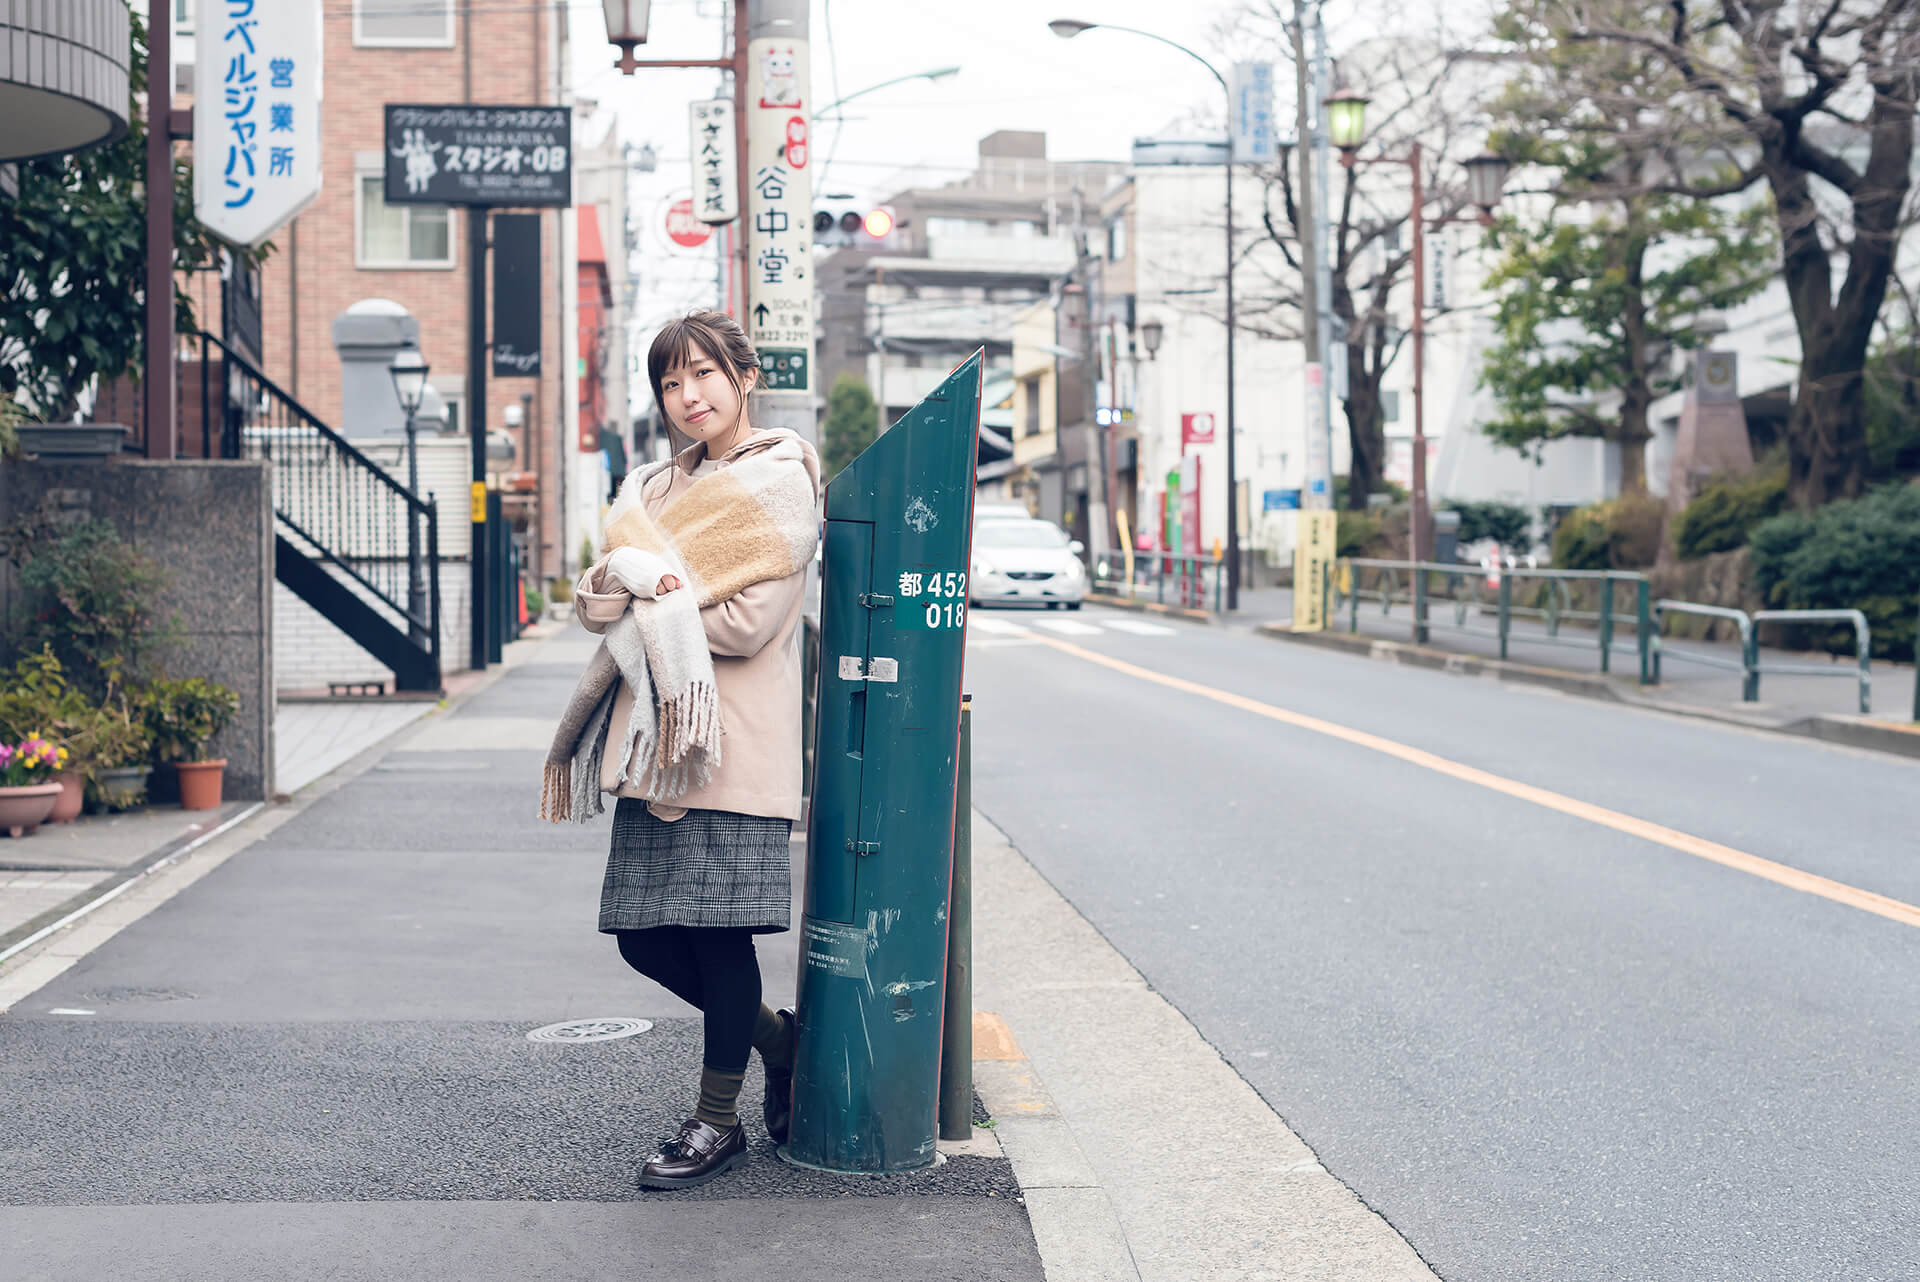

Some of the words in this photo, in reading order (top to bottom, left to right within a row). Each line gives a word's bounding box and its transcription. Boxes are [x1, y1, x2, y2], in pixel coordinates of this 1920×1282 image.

[268, 57, 295, 177] 営業所
[756, 165, 788, 283] 谷中堂
[898, 571, 923, 598] 都
[927, 572, 966, 598] 452
[926, 602, 964, 629] 018
